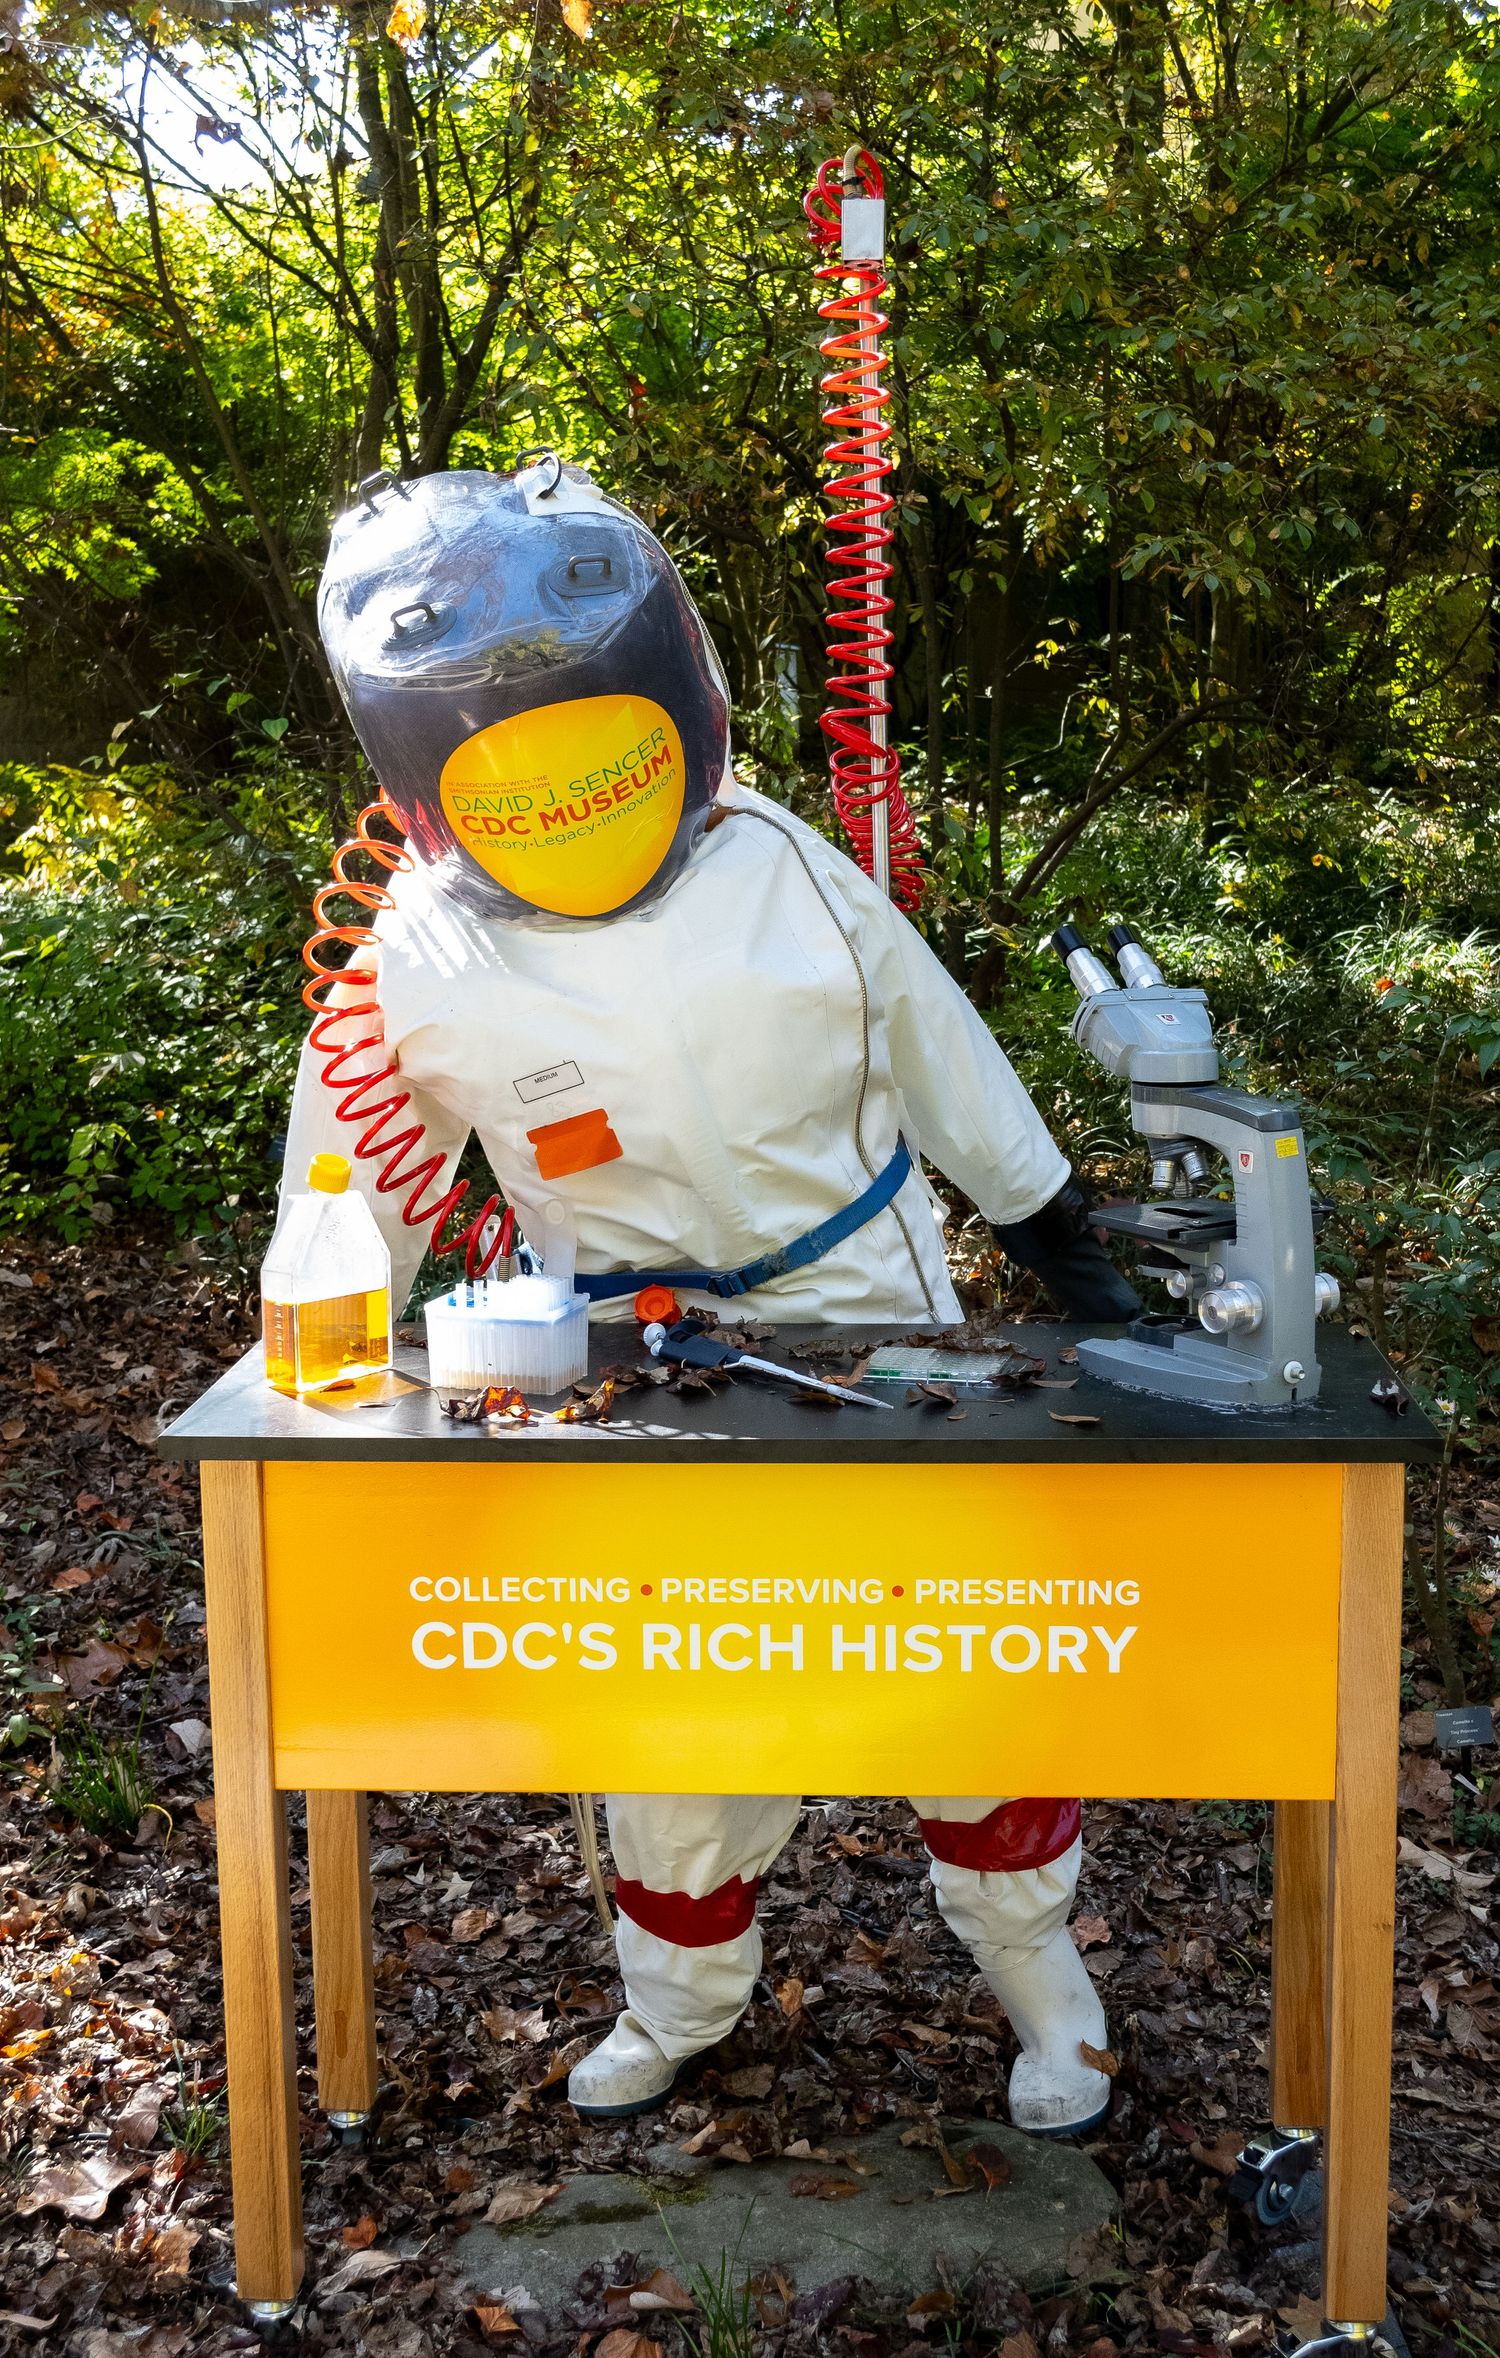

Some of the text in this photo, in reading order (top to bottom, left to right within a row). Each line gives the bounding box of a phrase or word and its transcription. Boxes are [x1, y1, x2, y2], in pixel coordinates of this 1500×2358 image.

[452, 727, 666, 813] DAVID J. SENCER
[508, 778, 530, 787] WITH
[533, 774, 549, 783] THE
[460, 744, 673, 836] CDC MUSEUM
[501, 781, 551, 794] INSTITUTION
[534, 1072, 558, 1084] MEDIUM
[409, 1576, 1141, 1607] COLLECTING PRESERVING PRESENTING
[411, 1621, 1139, 1674] CDC'S RICH HISTORY
